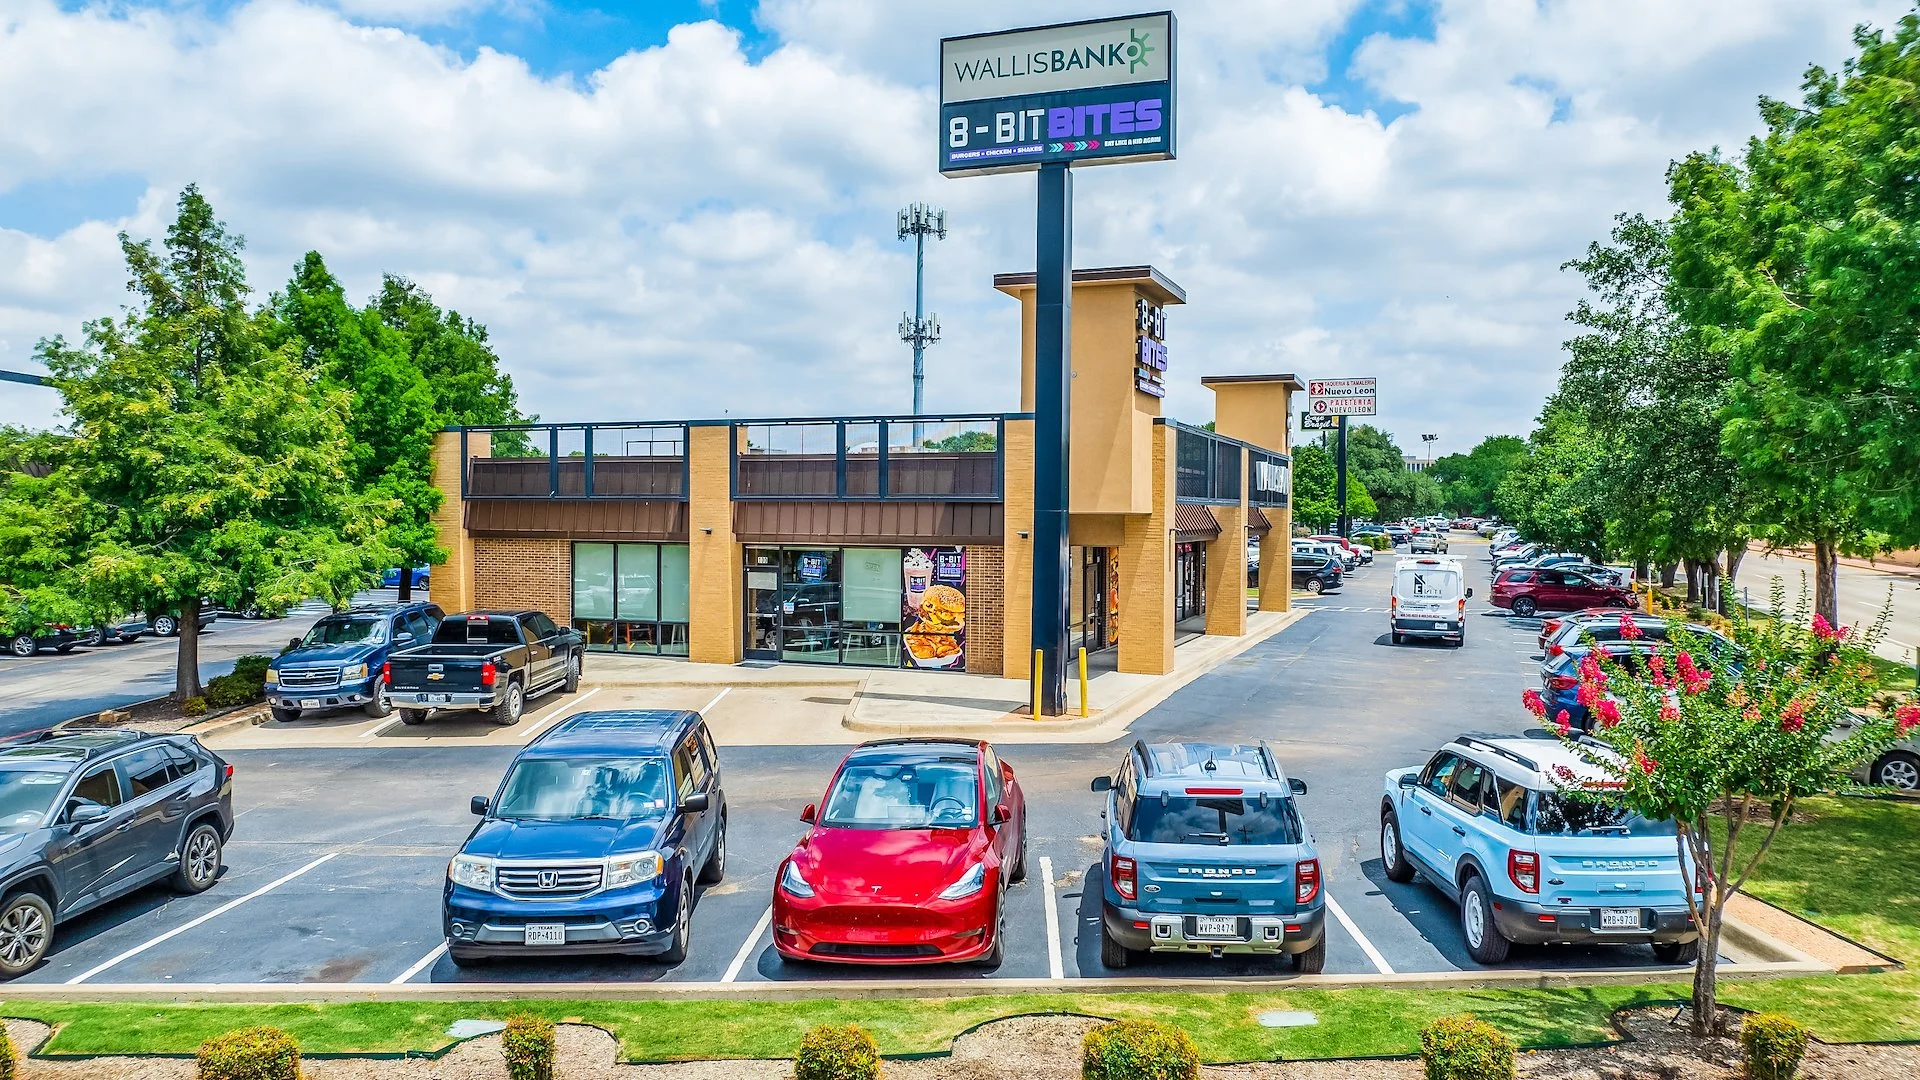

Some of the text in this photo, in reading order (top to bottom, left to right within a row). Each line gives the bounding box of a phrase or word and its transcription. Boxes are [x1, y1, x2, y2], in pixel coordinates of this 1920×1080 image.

[1047, 99, 1162, 139] BITES
[951, 145, 1043, 160] BURGERS CHICKEN SHAKES
[1138, 335, 1167, 372] BITES
[1177, 867, 1257, 875] BRONCO
[1582, 860, 1658, 868] BRONCO
